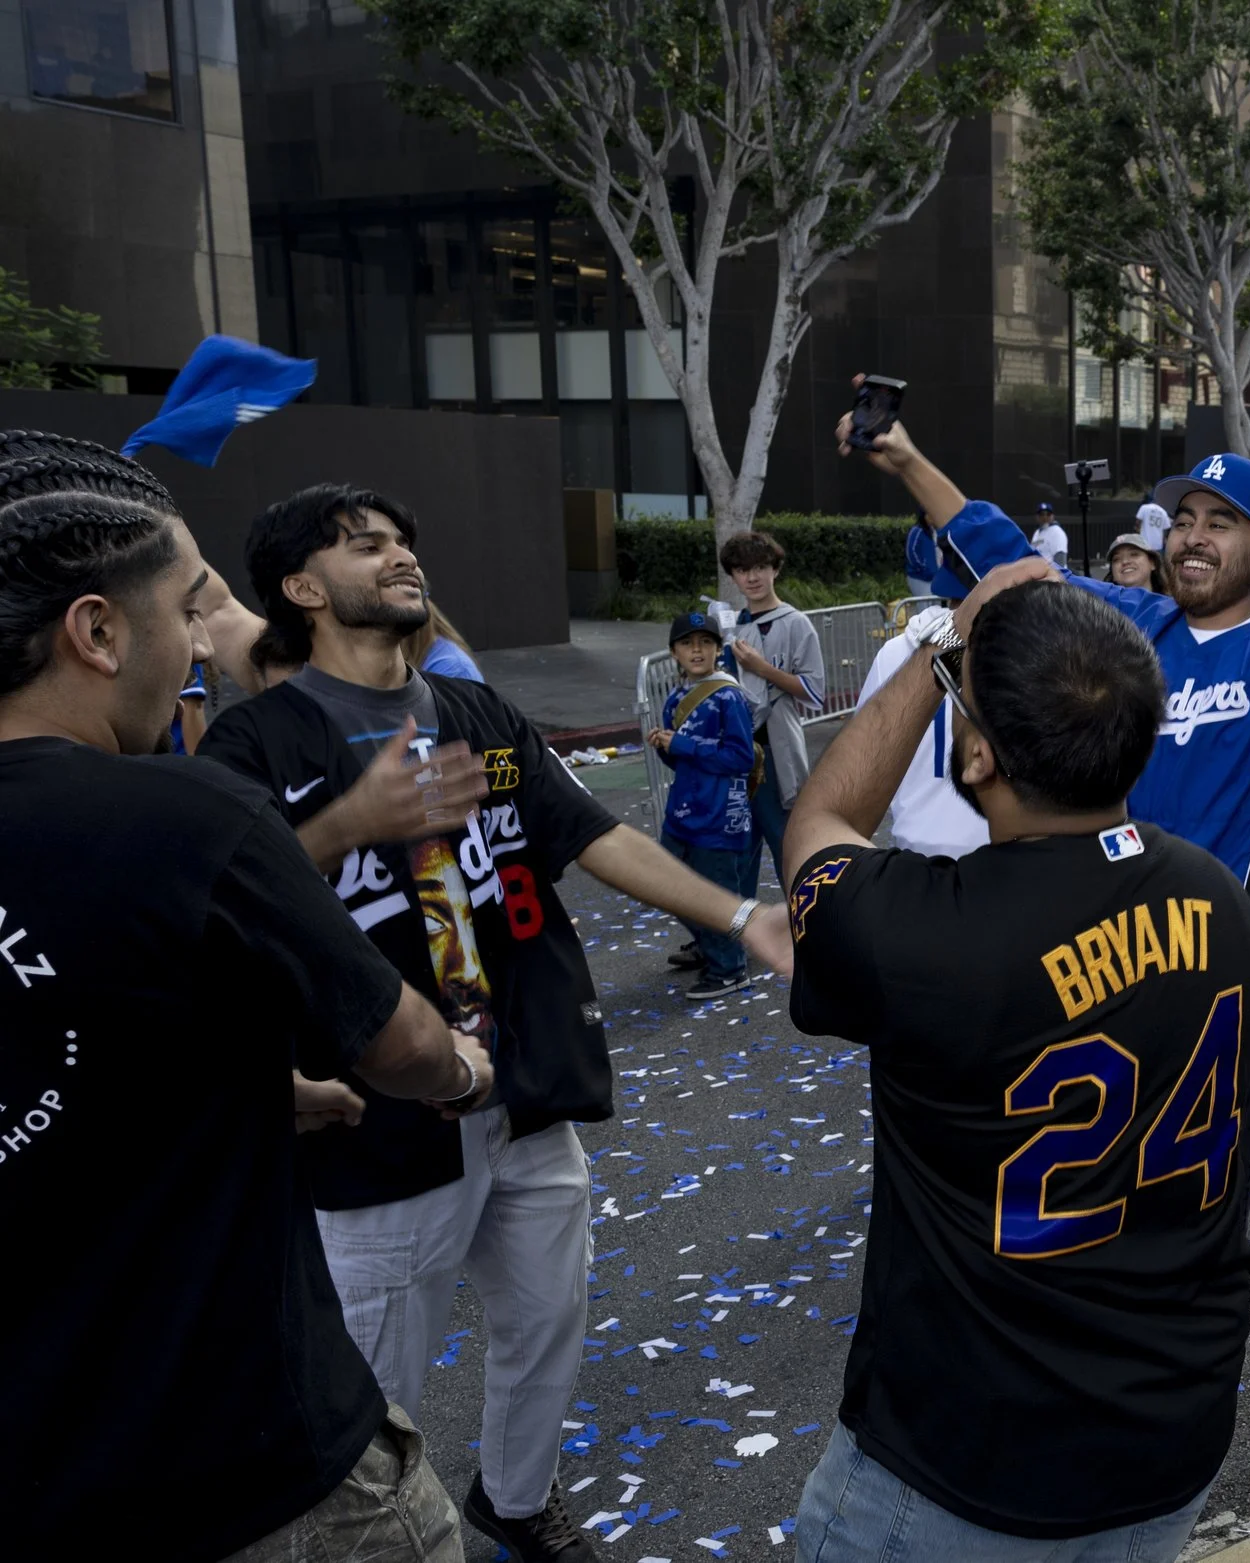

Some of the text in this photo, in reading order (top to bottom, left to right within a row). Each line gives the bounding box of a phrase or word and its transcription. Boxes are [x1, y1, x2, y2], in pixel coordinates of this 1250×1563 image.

[1202, 454, 1226, 481] LA
[500, 863, 545, 941] 8
[1041, 897, 1212, 1022] BRYANT
[0, 1089, 63, 1173] HOP
[993, 984, 1243, 1260] 24
